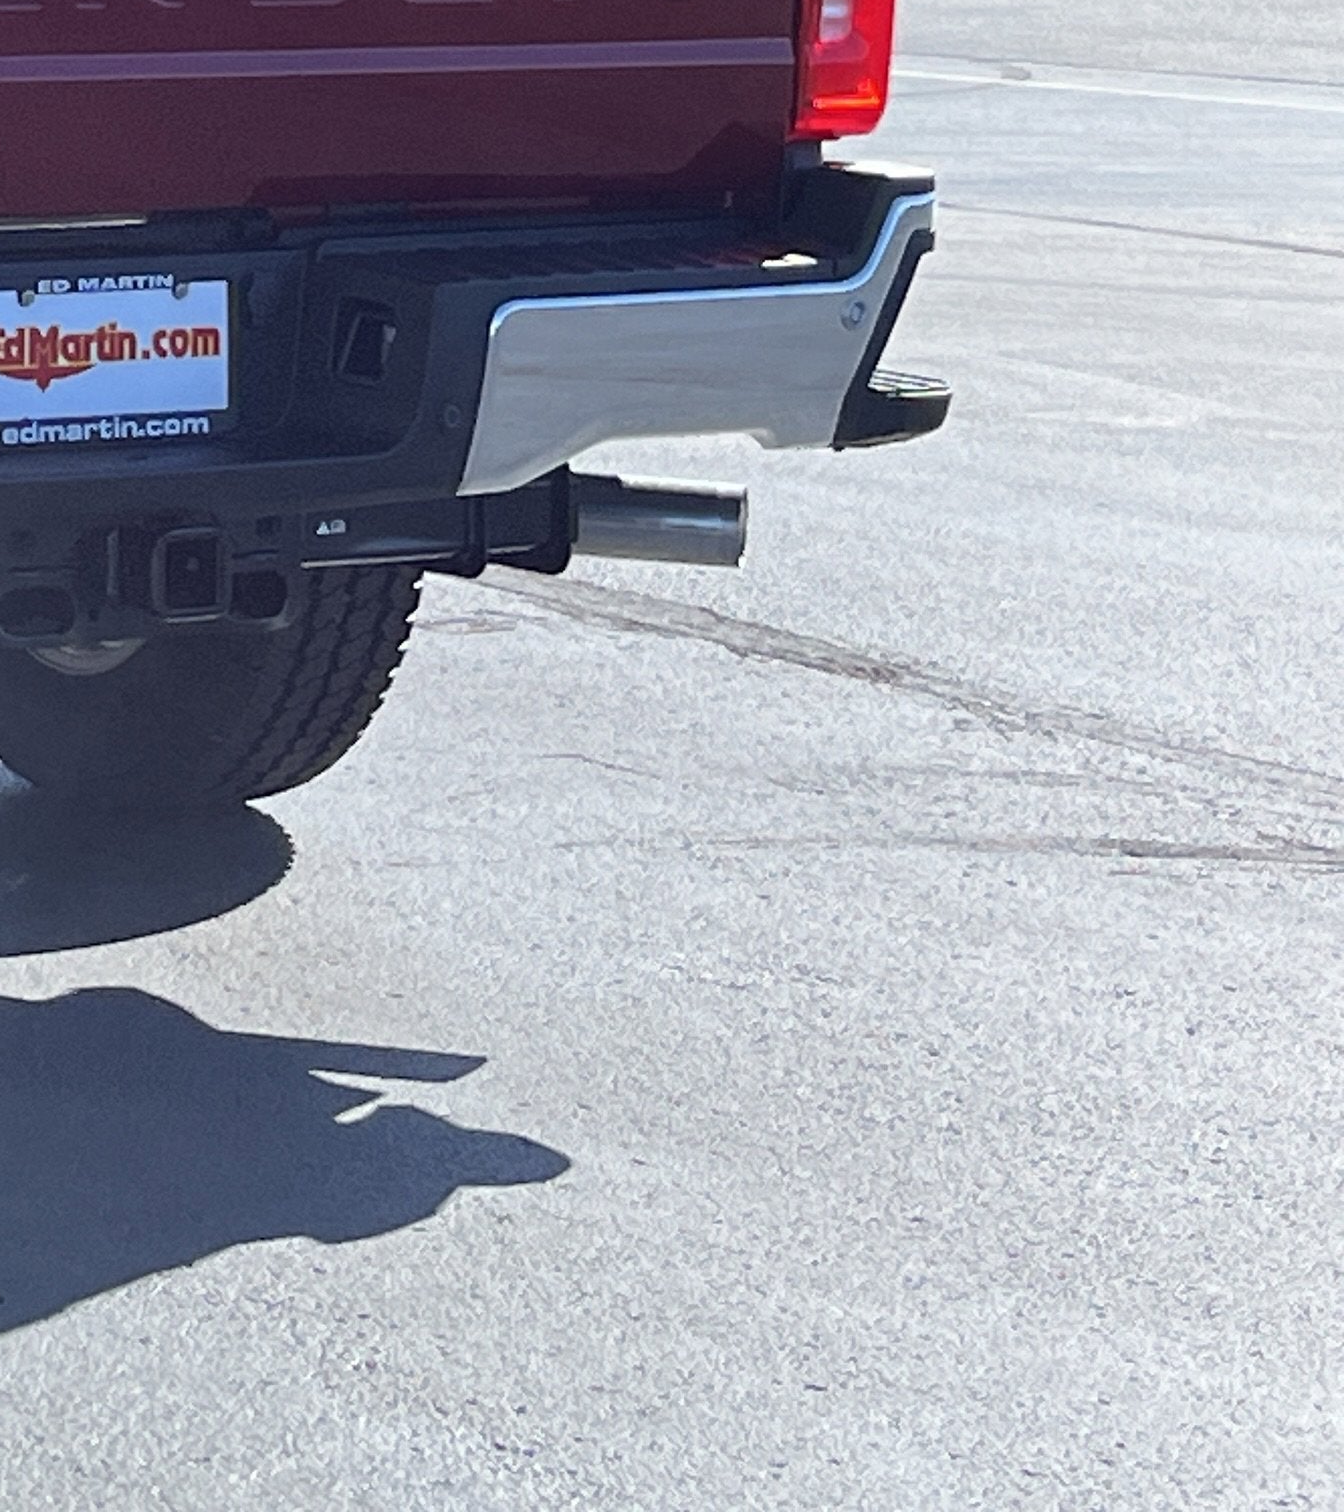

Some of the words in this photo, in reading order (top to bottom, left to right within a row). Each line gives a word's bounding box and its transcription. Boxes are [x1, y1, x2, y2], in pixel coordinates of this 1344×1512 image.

[37, 279, 71, 294] ED
[78, 273, 174, 292] MARTIN
[1, 416, 210, 445] edmartin.com
